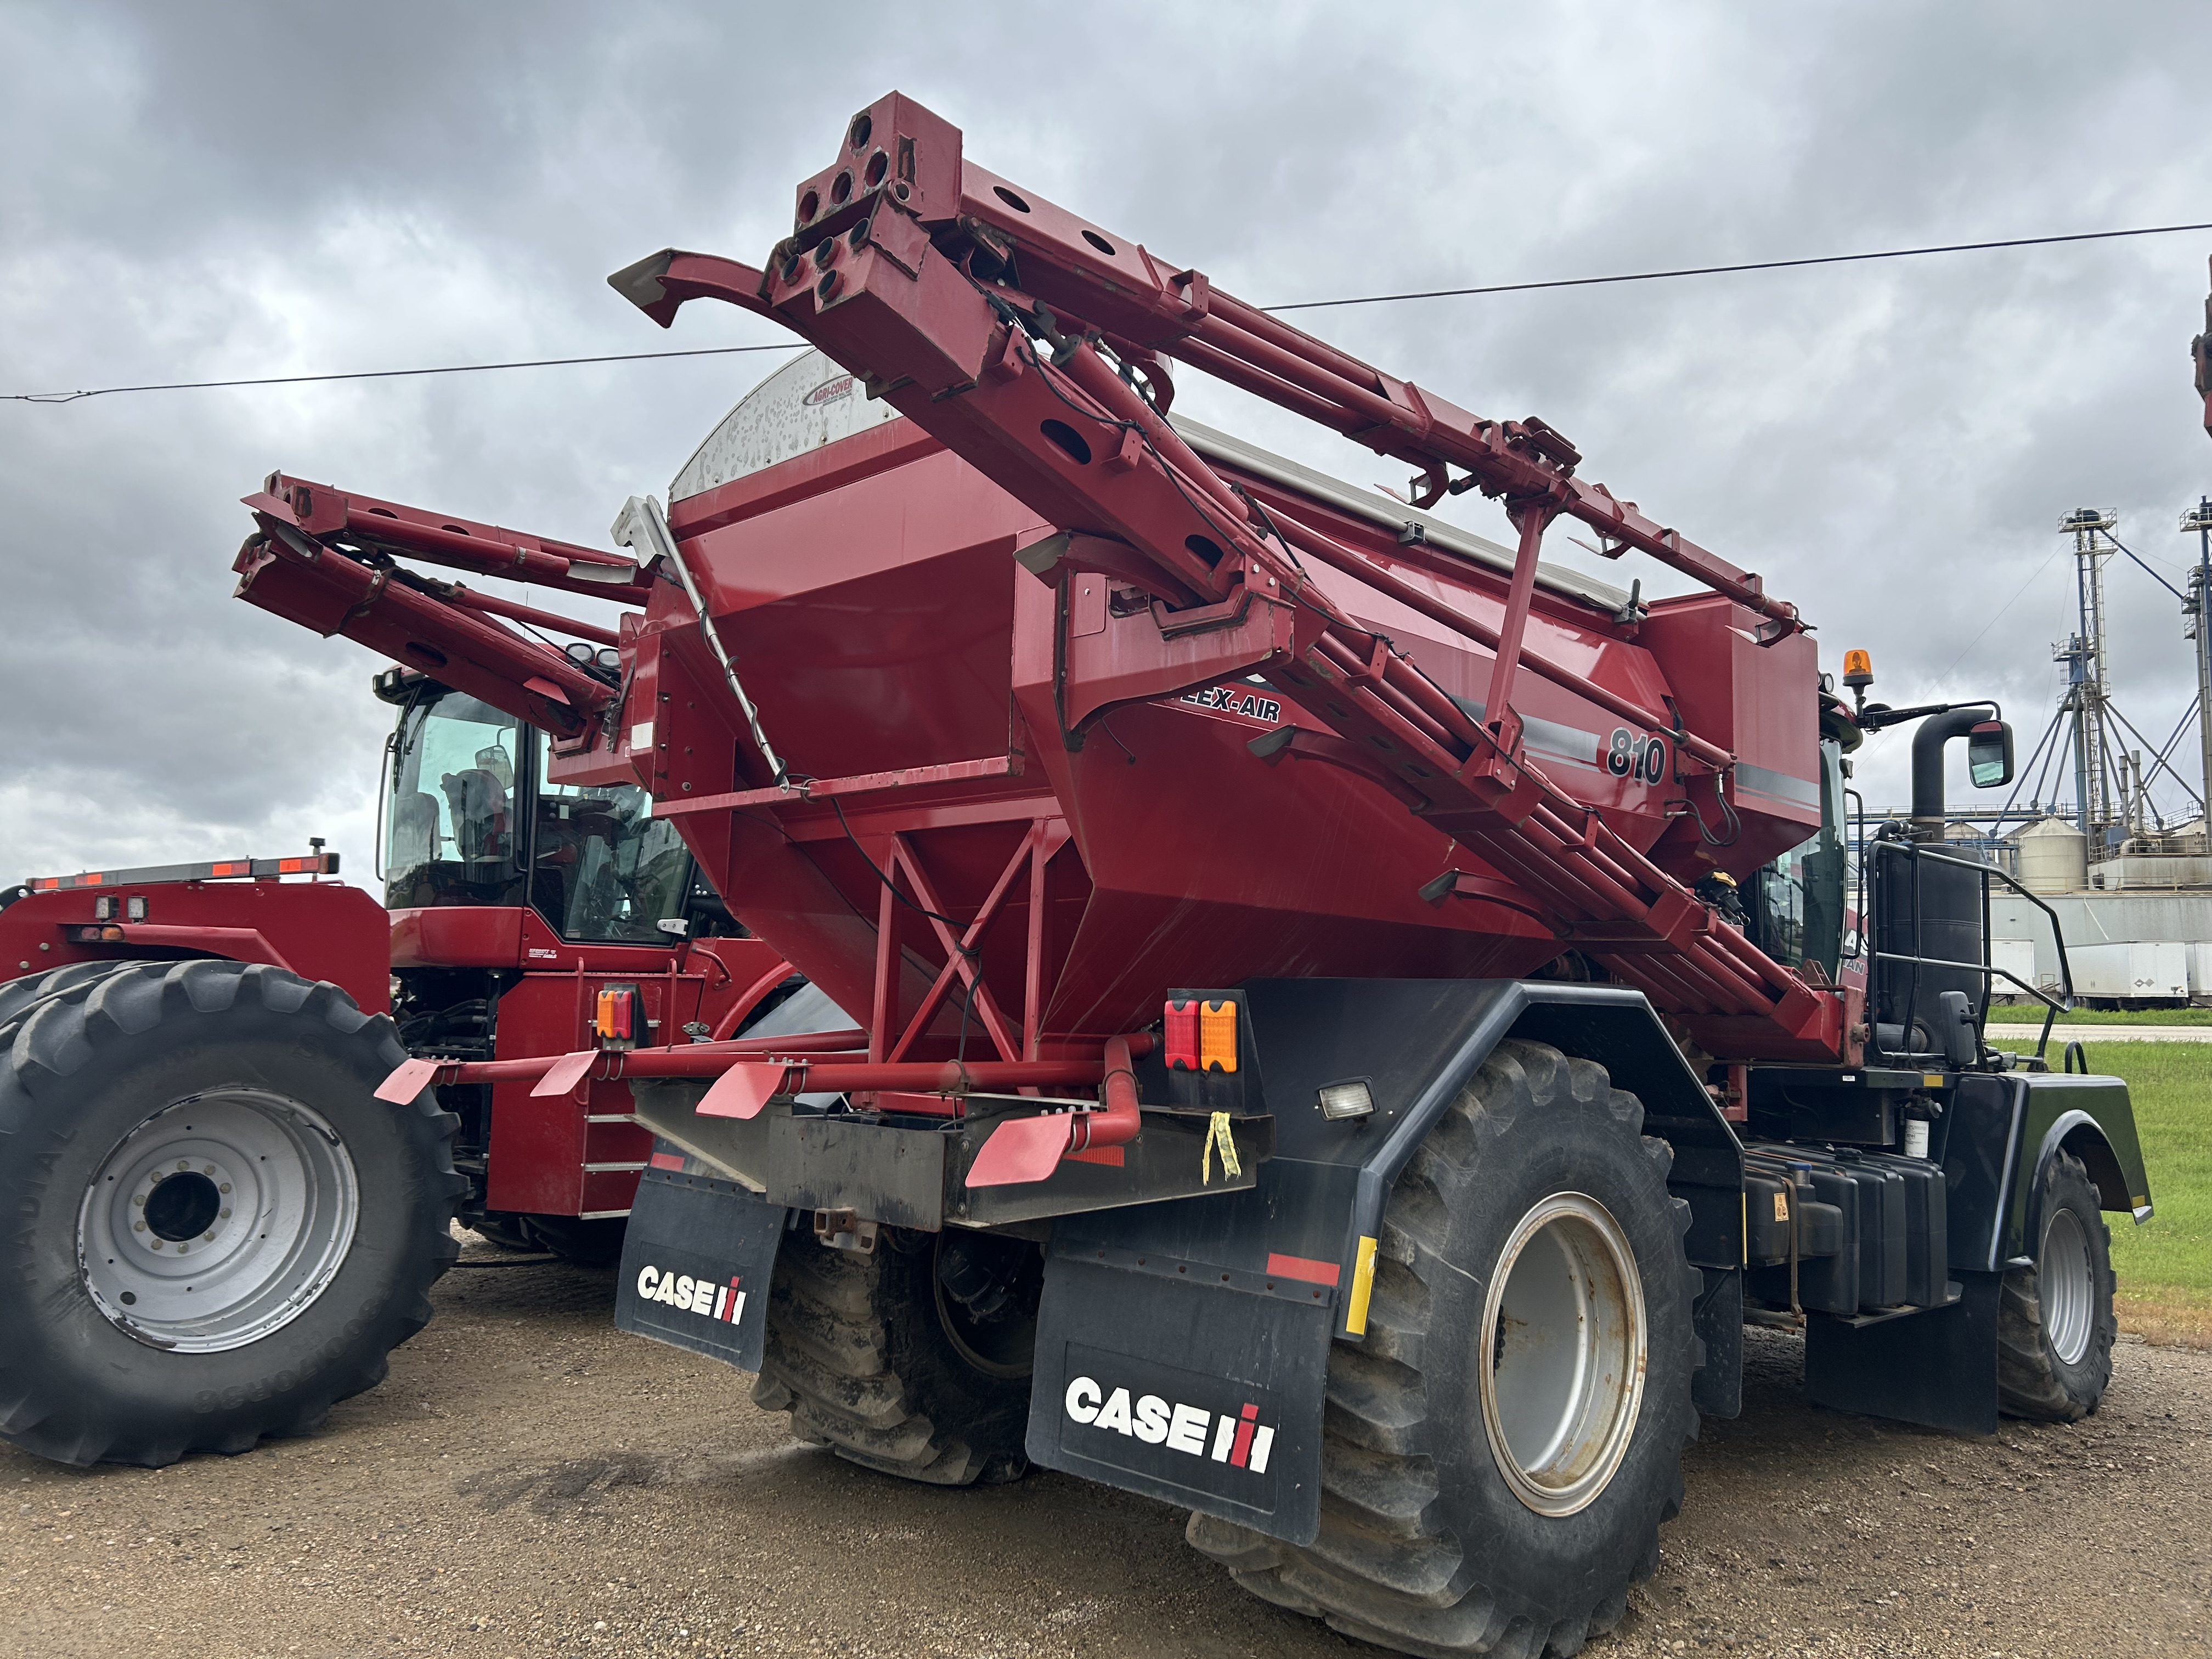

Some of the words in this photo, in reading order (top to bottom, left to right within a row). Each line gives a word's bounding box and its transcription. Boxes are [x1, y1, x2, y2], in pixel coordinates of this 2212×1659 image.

[813, 377, 853, 403] AGRI-COVER
[1180, 686, 1281, 723] LEX-AIR
[1606, 727, 1666, 786] 810
[8, 1128, 78, 1290] RADIAL
[637, 1265, 715, 1316] CASE
[1065, 1376, 1210, 1456] CASE
